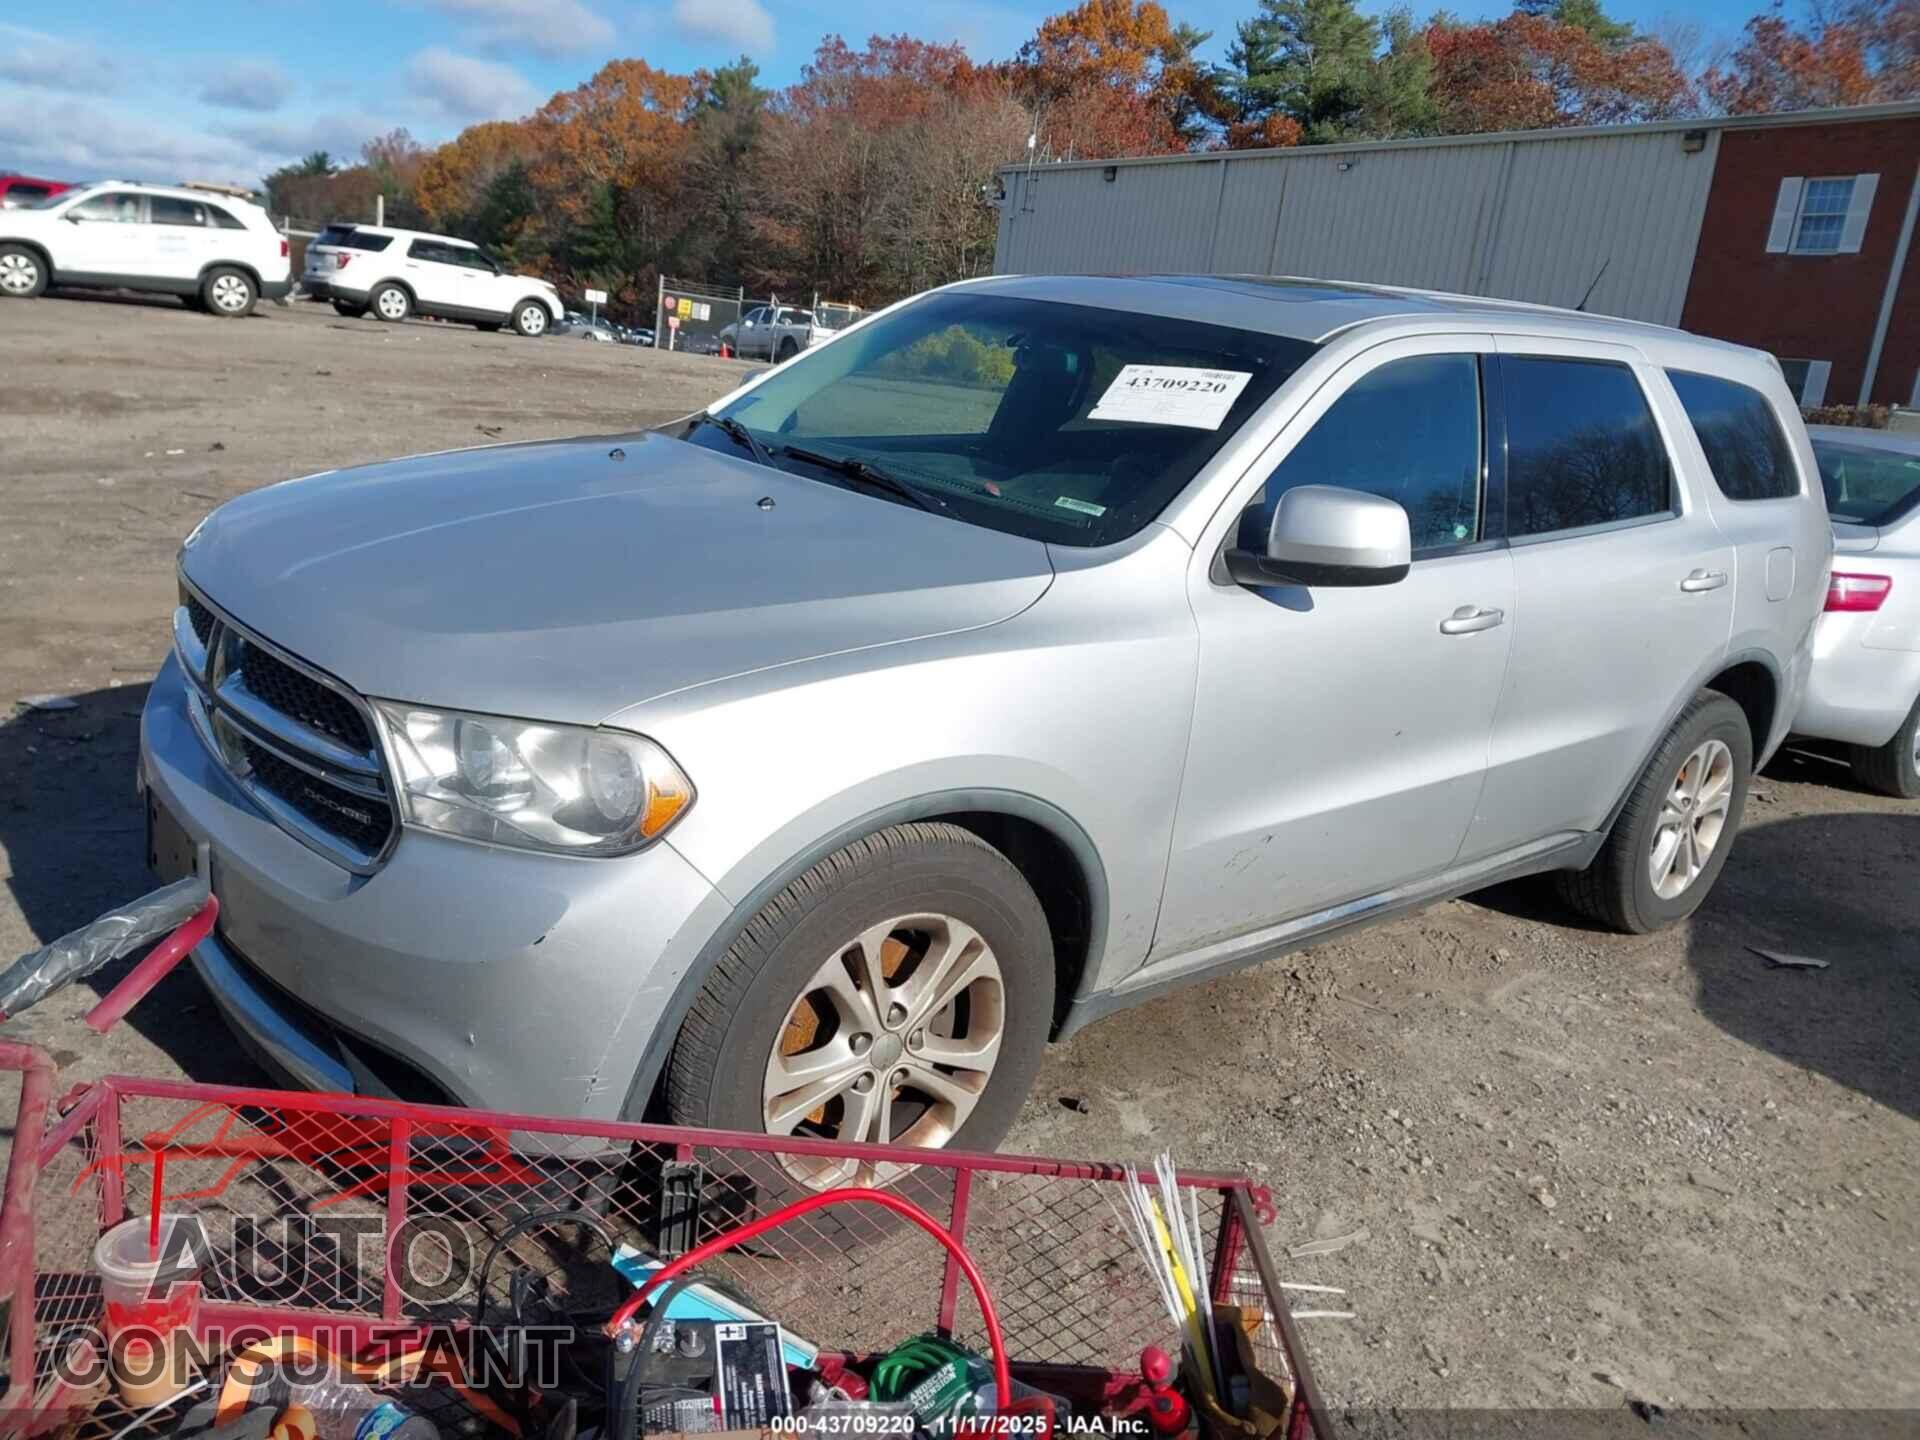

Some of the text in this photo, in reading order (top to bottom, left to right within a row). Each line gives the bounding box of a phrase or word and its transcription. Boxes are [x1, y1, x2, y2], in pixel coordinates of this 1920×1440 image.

[1126, 377, 1227, 393] 43709220
[910, 1363, 956, 1401] ANDSCAPE
[911, 1372, 957, 1409] XTENSION
